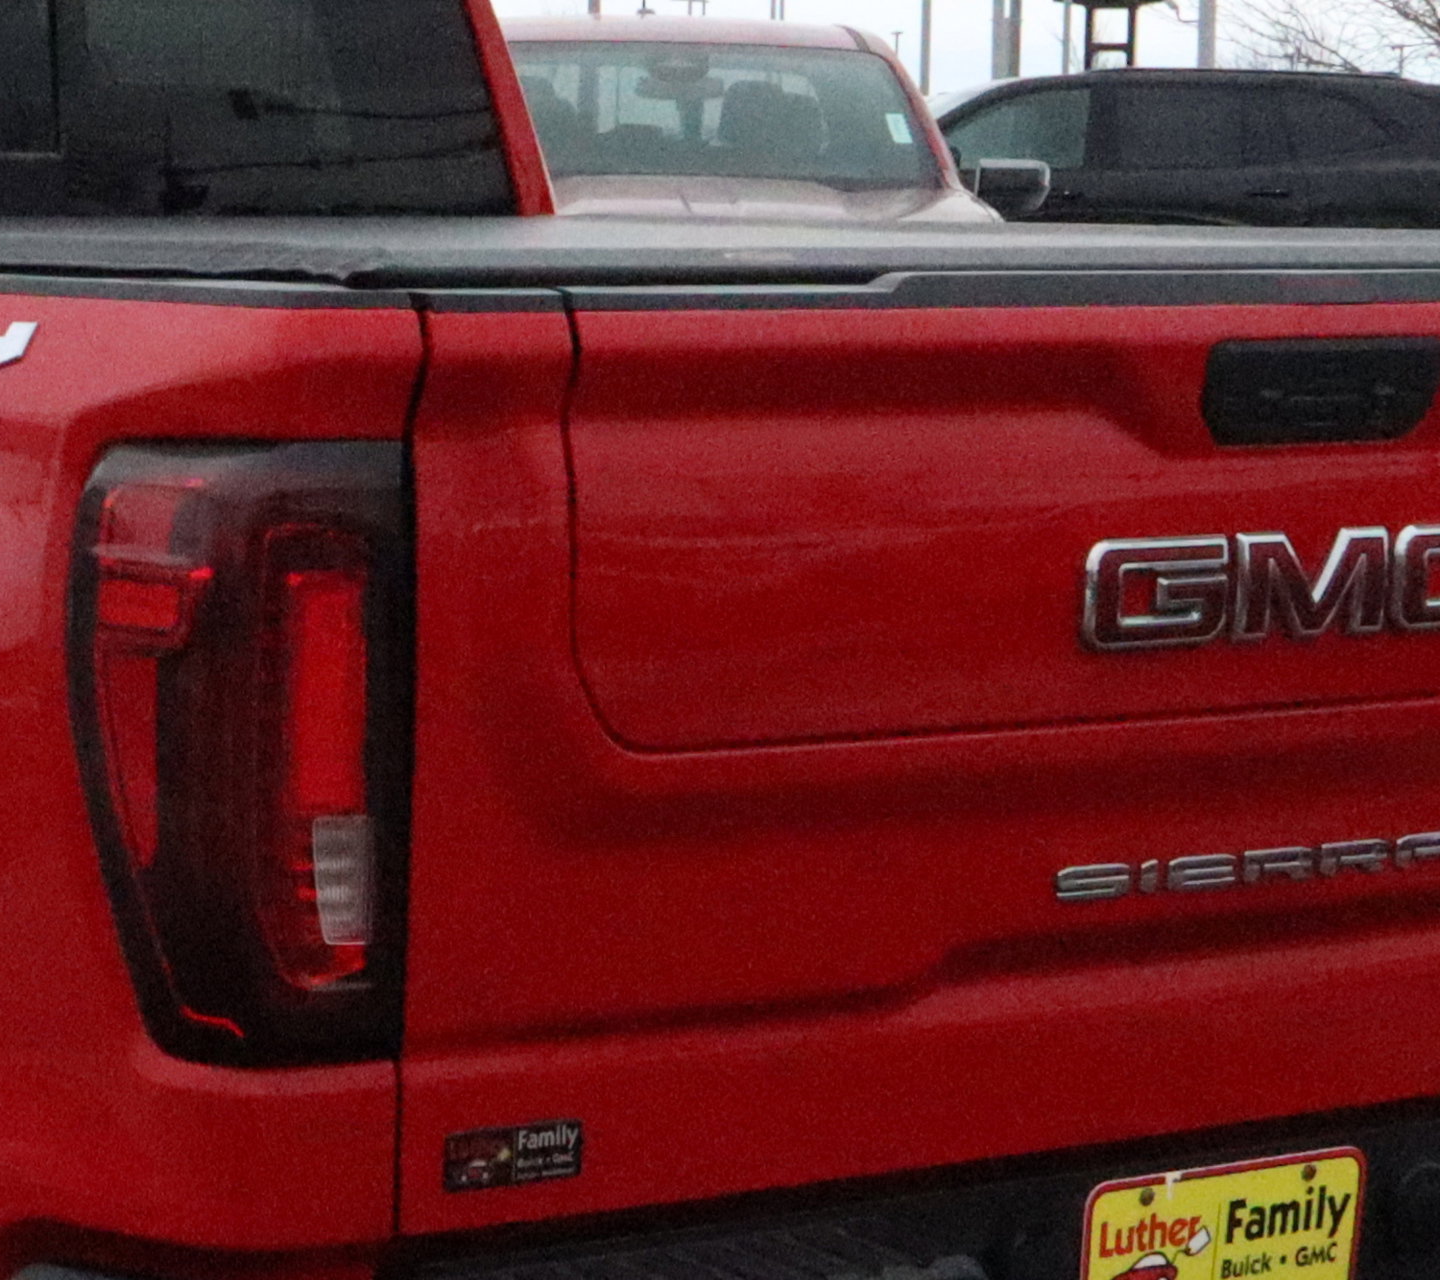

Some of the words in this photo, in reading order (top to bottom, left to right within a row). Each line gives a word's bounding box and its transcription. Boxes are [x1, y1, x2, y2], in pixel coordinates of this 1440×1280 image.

[517, 1123, 579, 1151] Family
[1098, 1212, 1203, 1259] Luther
[1225, 1185, 1352, 1245] Family
[1220, 1253, 1272, 1280] Buick
[1295, 1241, 1338, 1268] GMC
